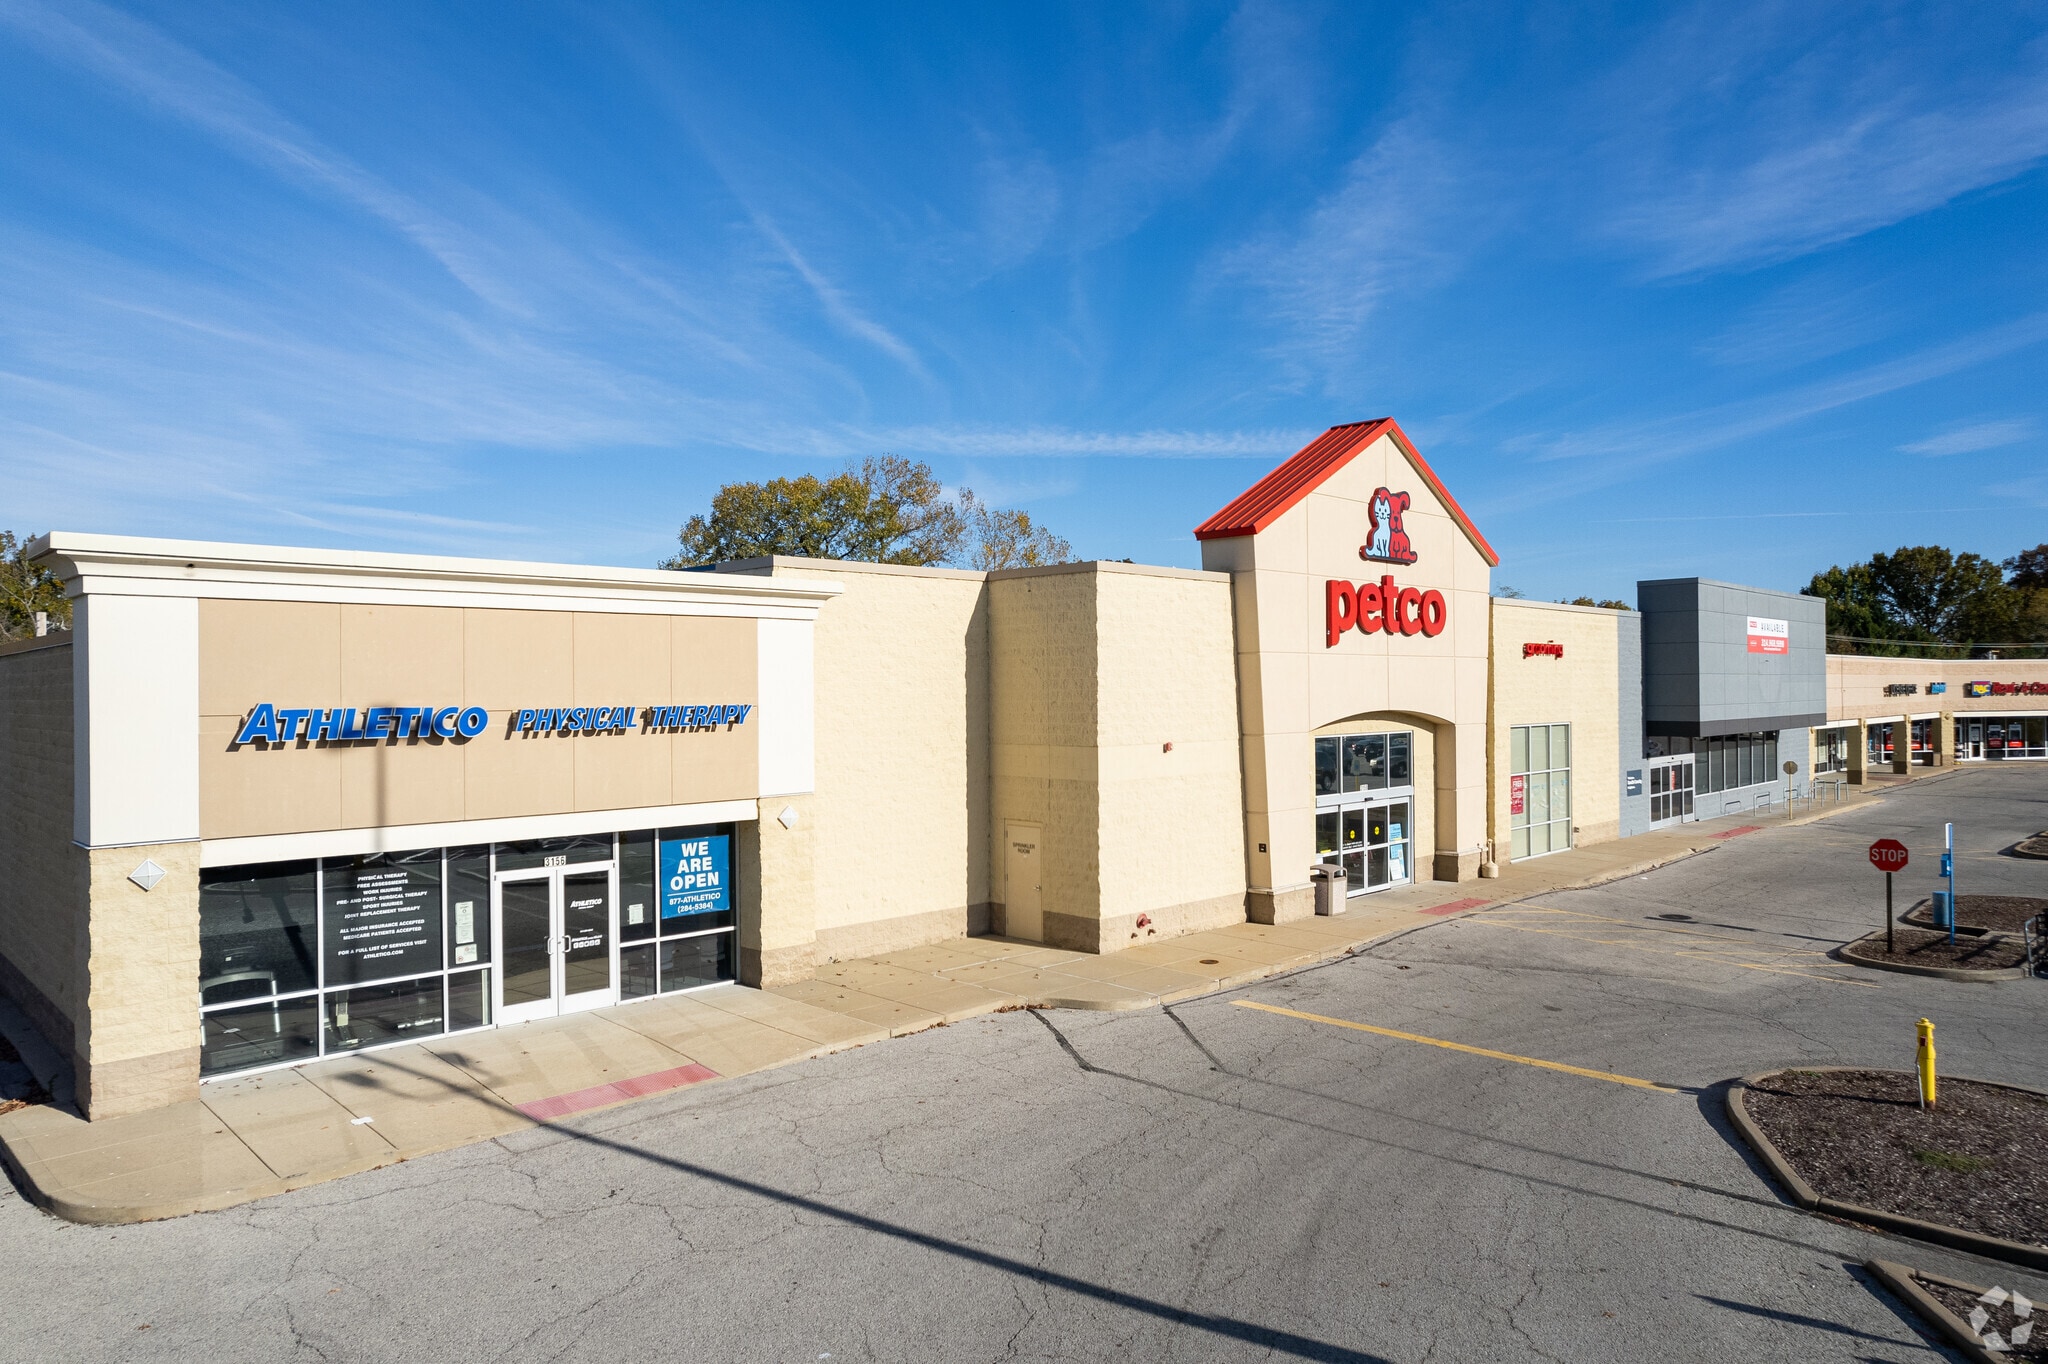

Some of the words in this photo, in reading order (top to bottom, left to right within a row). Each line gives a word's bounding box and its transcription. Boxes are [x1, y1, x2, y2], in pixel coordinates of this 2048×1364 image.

[1326, 575, 1446, 648] petco
[236, 703, 489, 744] ATHLETICO
[515, 706, 637, 732] PHYSICAL
[651, 704, 753, 728] THERAPY
[681, 841, 709, 857] WE
[1871, 848, 1906, 862] STOP
[545, 856, 566, 867] 3156
[677, 856, 712, 874] ARE
[371, 879, 408, 887] ASSESSMENTS
[670, 872, 719, 891] OPEN
[570, 898, 602, 908] ATHLETICO
[669, 892, 721, 905] 877-ATHLETICO
[360, 909, 397, 917] REPLACEMENT
[677, 901, 713, 914] (284-5384)
[369, 922, 398, 930] INSURANCE
[371, 929, 395, 937] PATIENTS
[396, 926, 422, 934] ACCEPTED
[389, 941, 414, 949] SERVICES
[363, 949, 404, 959] ATHLETICO.COM
